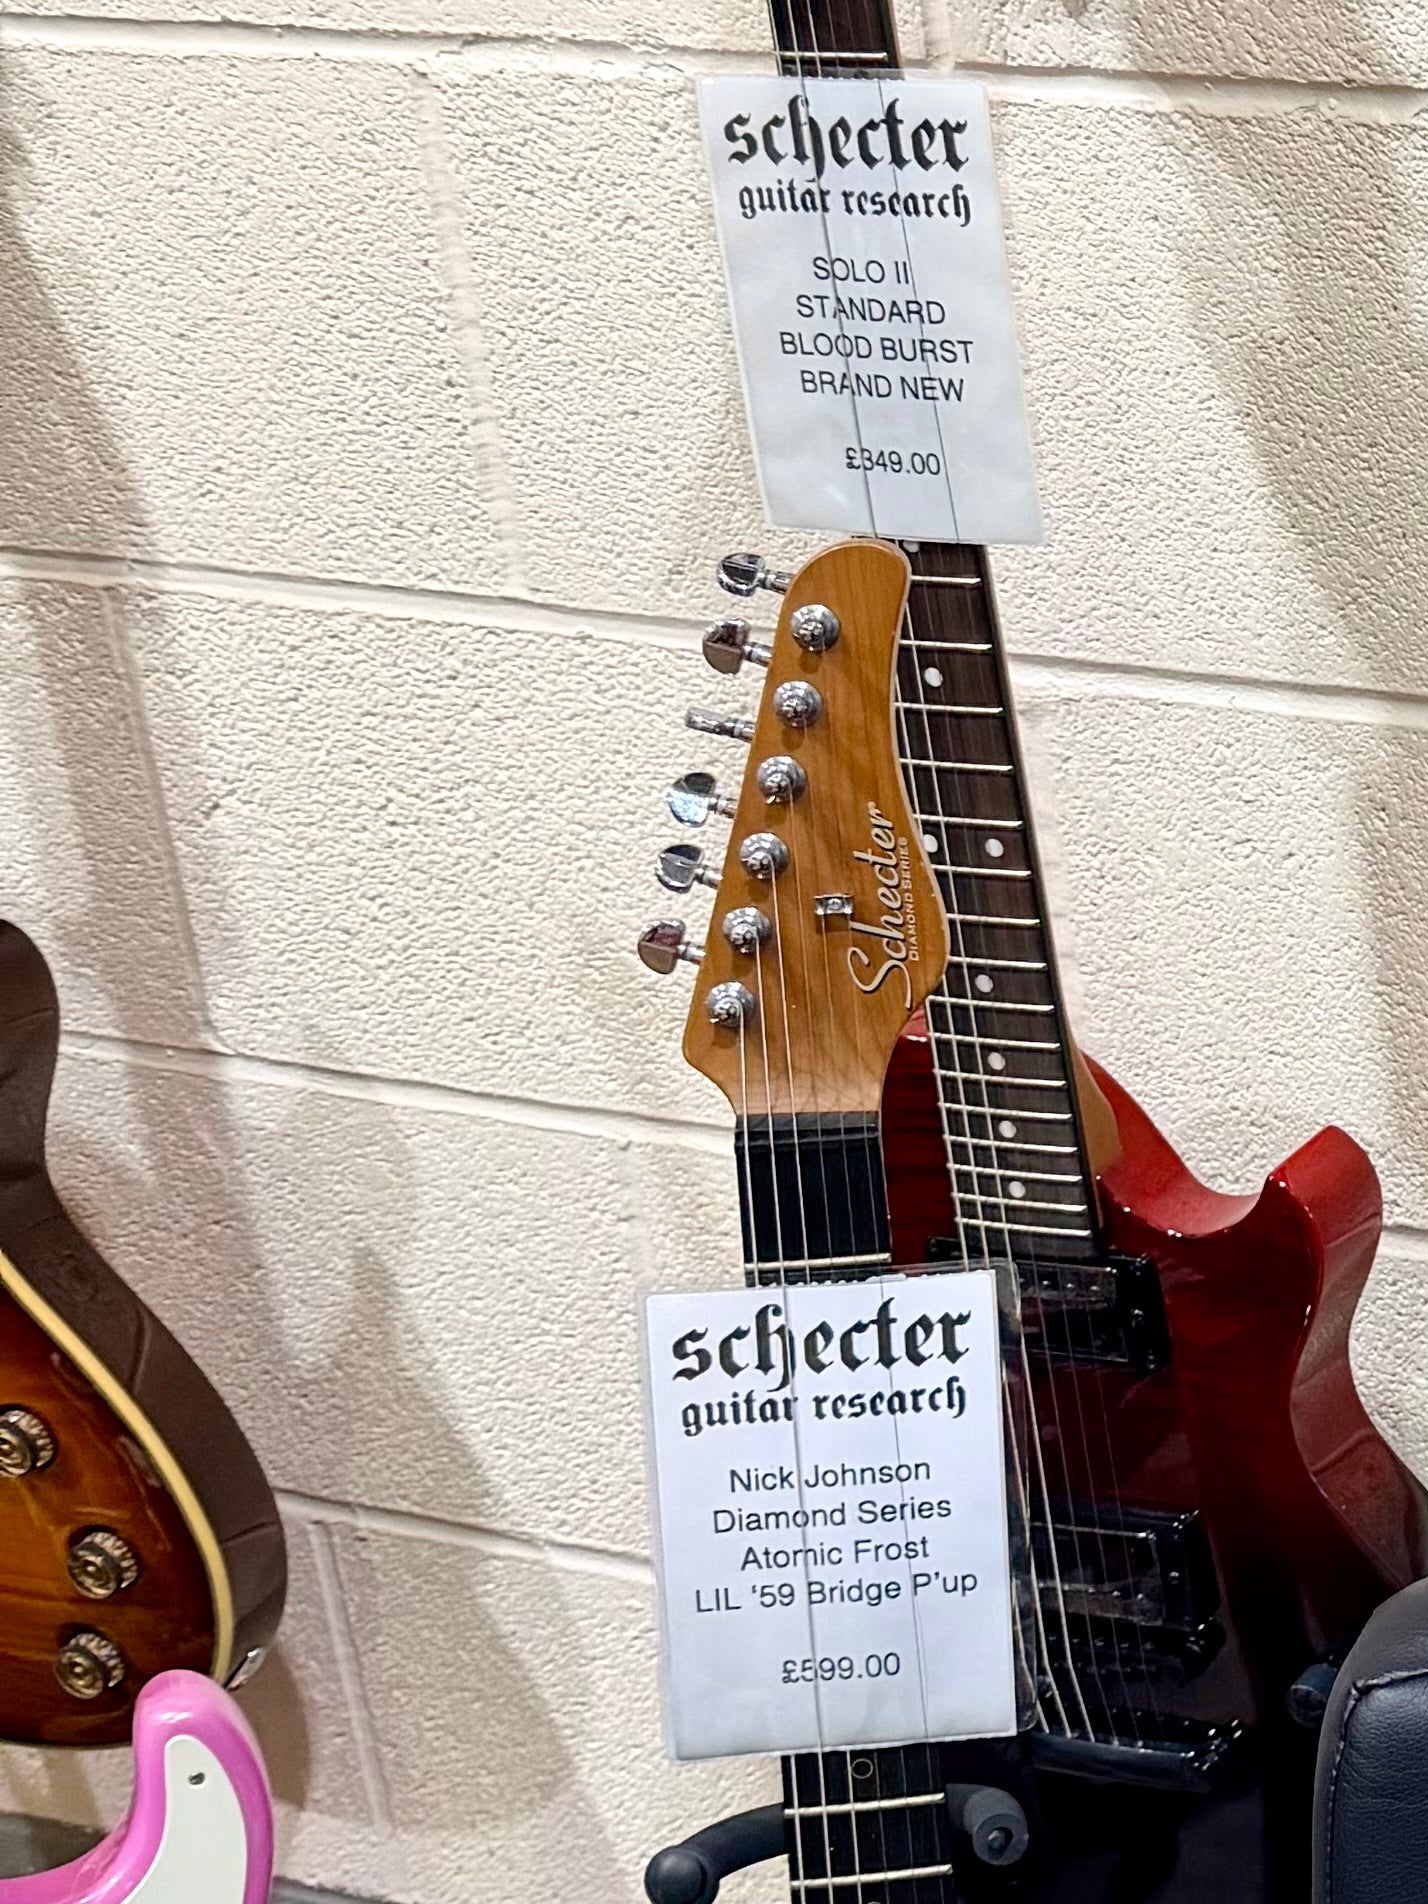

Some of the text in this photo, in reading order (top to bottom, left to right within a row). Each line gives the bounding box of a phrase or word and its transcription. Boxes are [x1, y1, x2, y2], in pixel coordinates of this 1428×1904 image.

[723, 94, 969, 180] schecter
[739, 178, 971, 228] guitar research
[812, 257, 911, 285] SOLO II
[796, 295, 946, 326] STANDARD
[779, 332, 974, 365] BLOOD BURST
[800, 369, 964, 402] BRAND NEW
[845, 447, 941, 476] £349.00
[848, 800, 912, 1008] Schecter
[897, 836, 919, 961] DIAMOND SERIES
[671, 1297, 972, 1393] schecter
[681, 1375, 967, 1437] guitar research
[730, 1460, 931, 1493] Nick Johnson
[713, 1496, 953, 1534] Diamond Series
[740, 1536, 930, 1571] Atomic Frost
[695, 1587, 741, 1613] LIL
[808, 1579, 902, 1608] Bridge
[781, 1652, 901, 1684] £599.00
